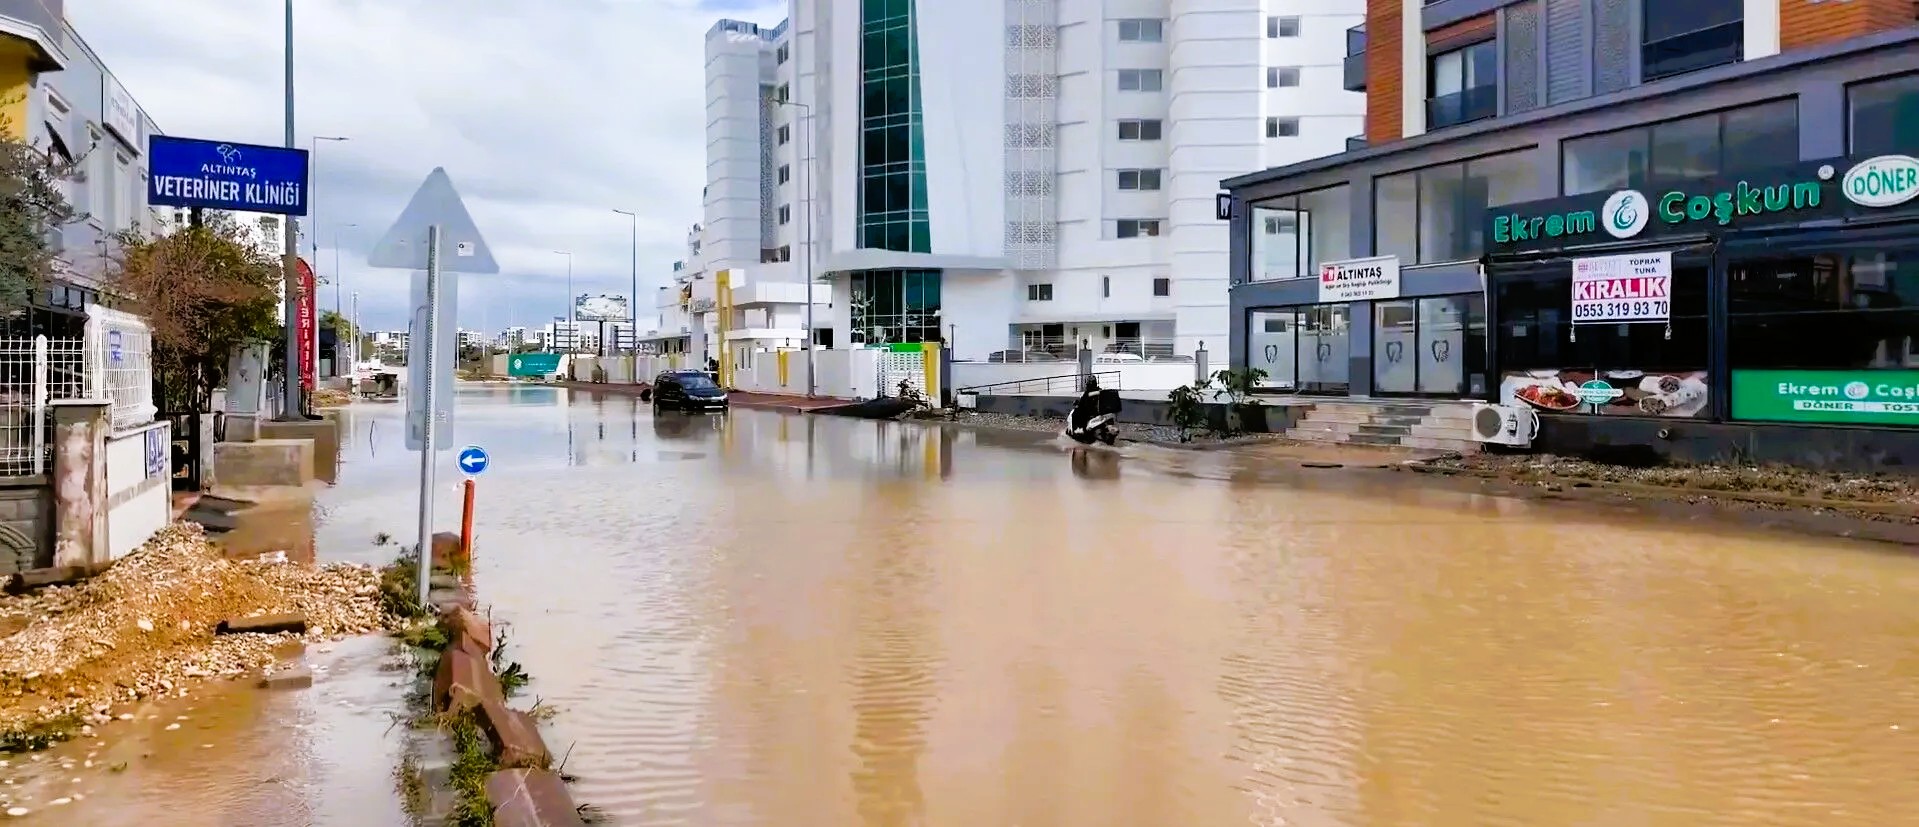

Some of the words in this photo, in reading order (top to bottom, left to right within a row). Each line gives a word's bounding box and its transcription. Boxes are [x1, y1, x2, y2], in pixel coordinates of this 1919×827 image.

[201, 163, 256, 179] ALTINTAŞ
[1853, 166, 1917, 196] DÖNER
[154, 174, 240, 202] VETERİNER
[245, 180, 300, 206] KLİNİĞİ
[1495, 210, 1595, 243] Ekrem
[1658, 180, 1821, 225] Coşkun
[1630, 258, 1661, 266] TOPRAK
[1337, 267, 1382, 280] ALTINTAŞ
[1575, 303, 1604, 318] 0553
[1607, 302, 1630, 317] 319
[1634, 301, 1649, 316] 93
[1654, 300, 1668, 315] 70
[1778, 382, 1839, 396] Ekrem
